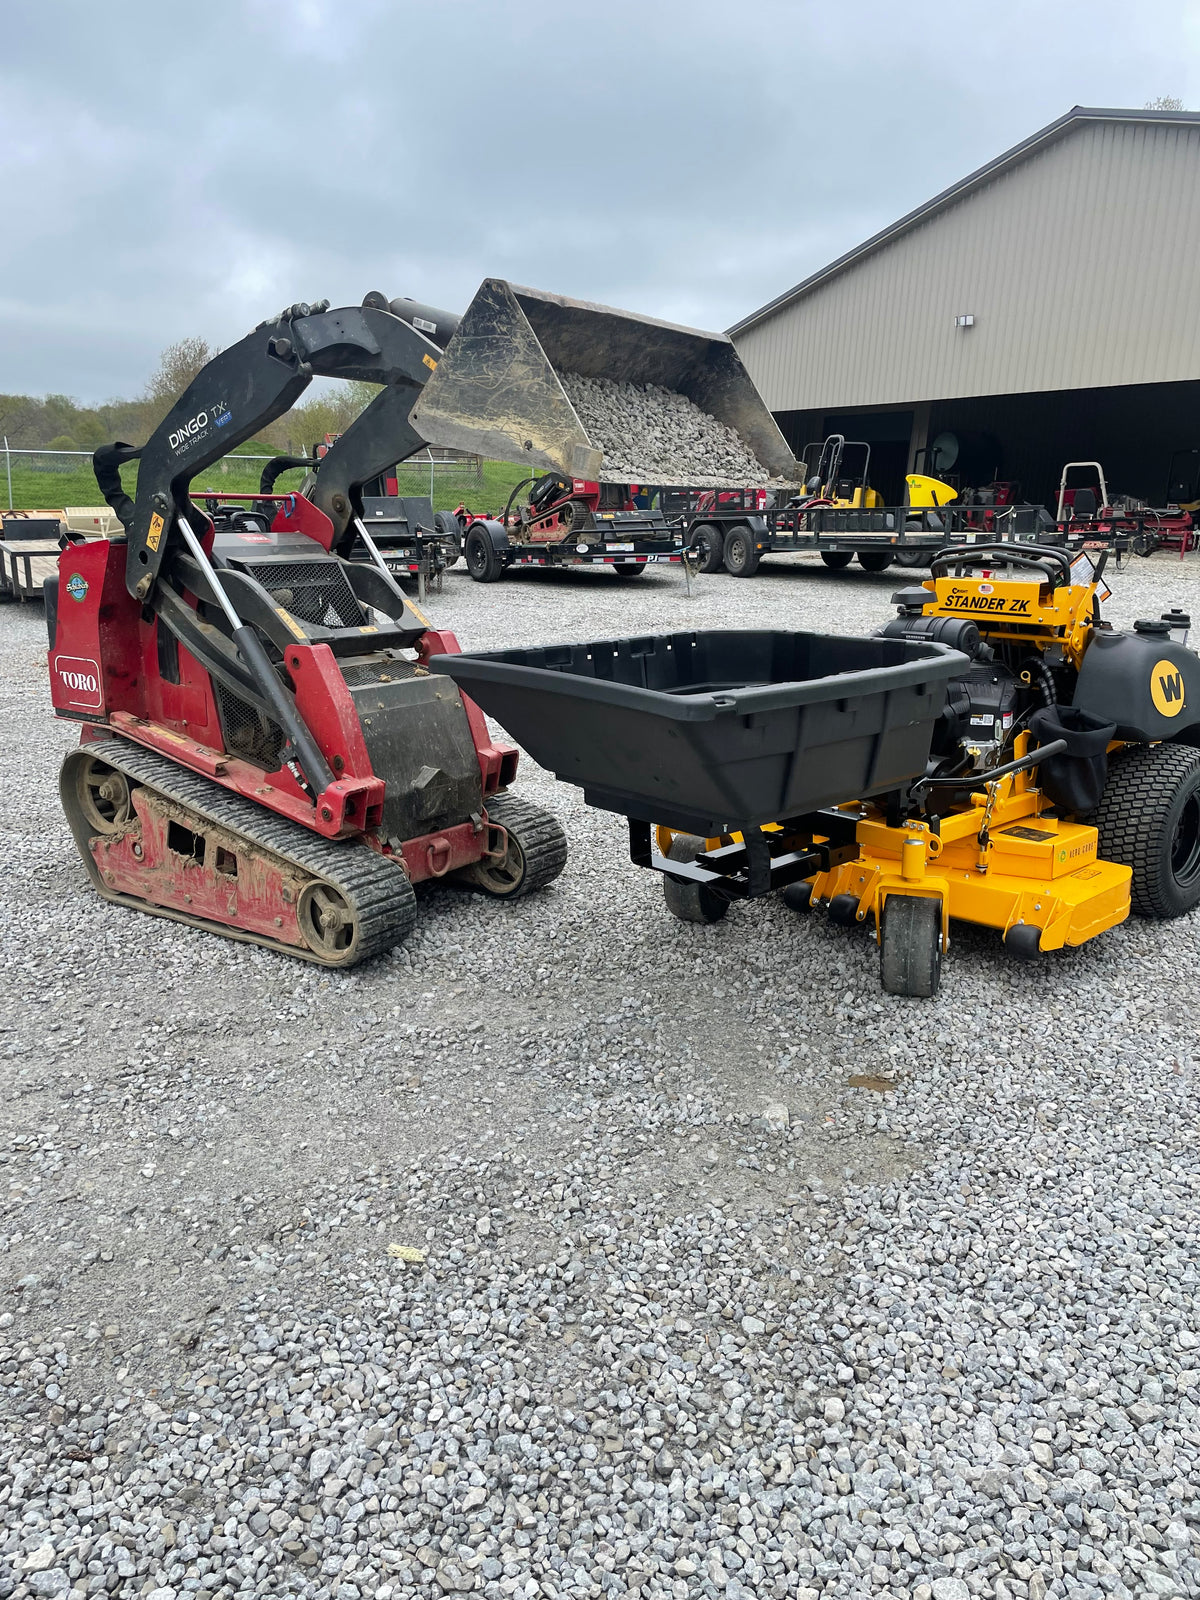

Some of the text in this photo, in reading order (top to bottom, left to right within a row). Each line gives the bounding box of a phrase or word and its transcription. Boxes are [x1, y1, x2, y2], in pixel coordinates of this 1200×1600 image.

[169, 400, 225, 450] DINGO TX
[175, 429, 209, 457] WIDE TRACK
[945, 595, 1031, 612] STANDER ZK
[60, 671, 97, 692] TORO
[1159, 672, 1181, 703] W
